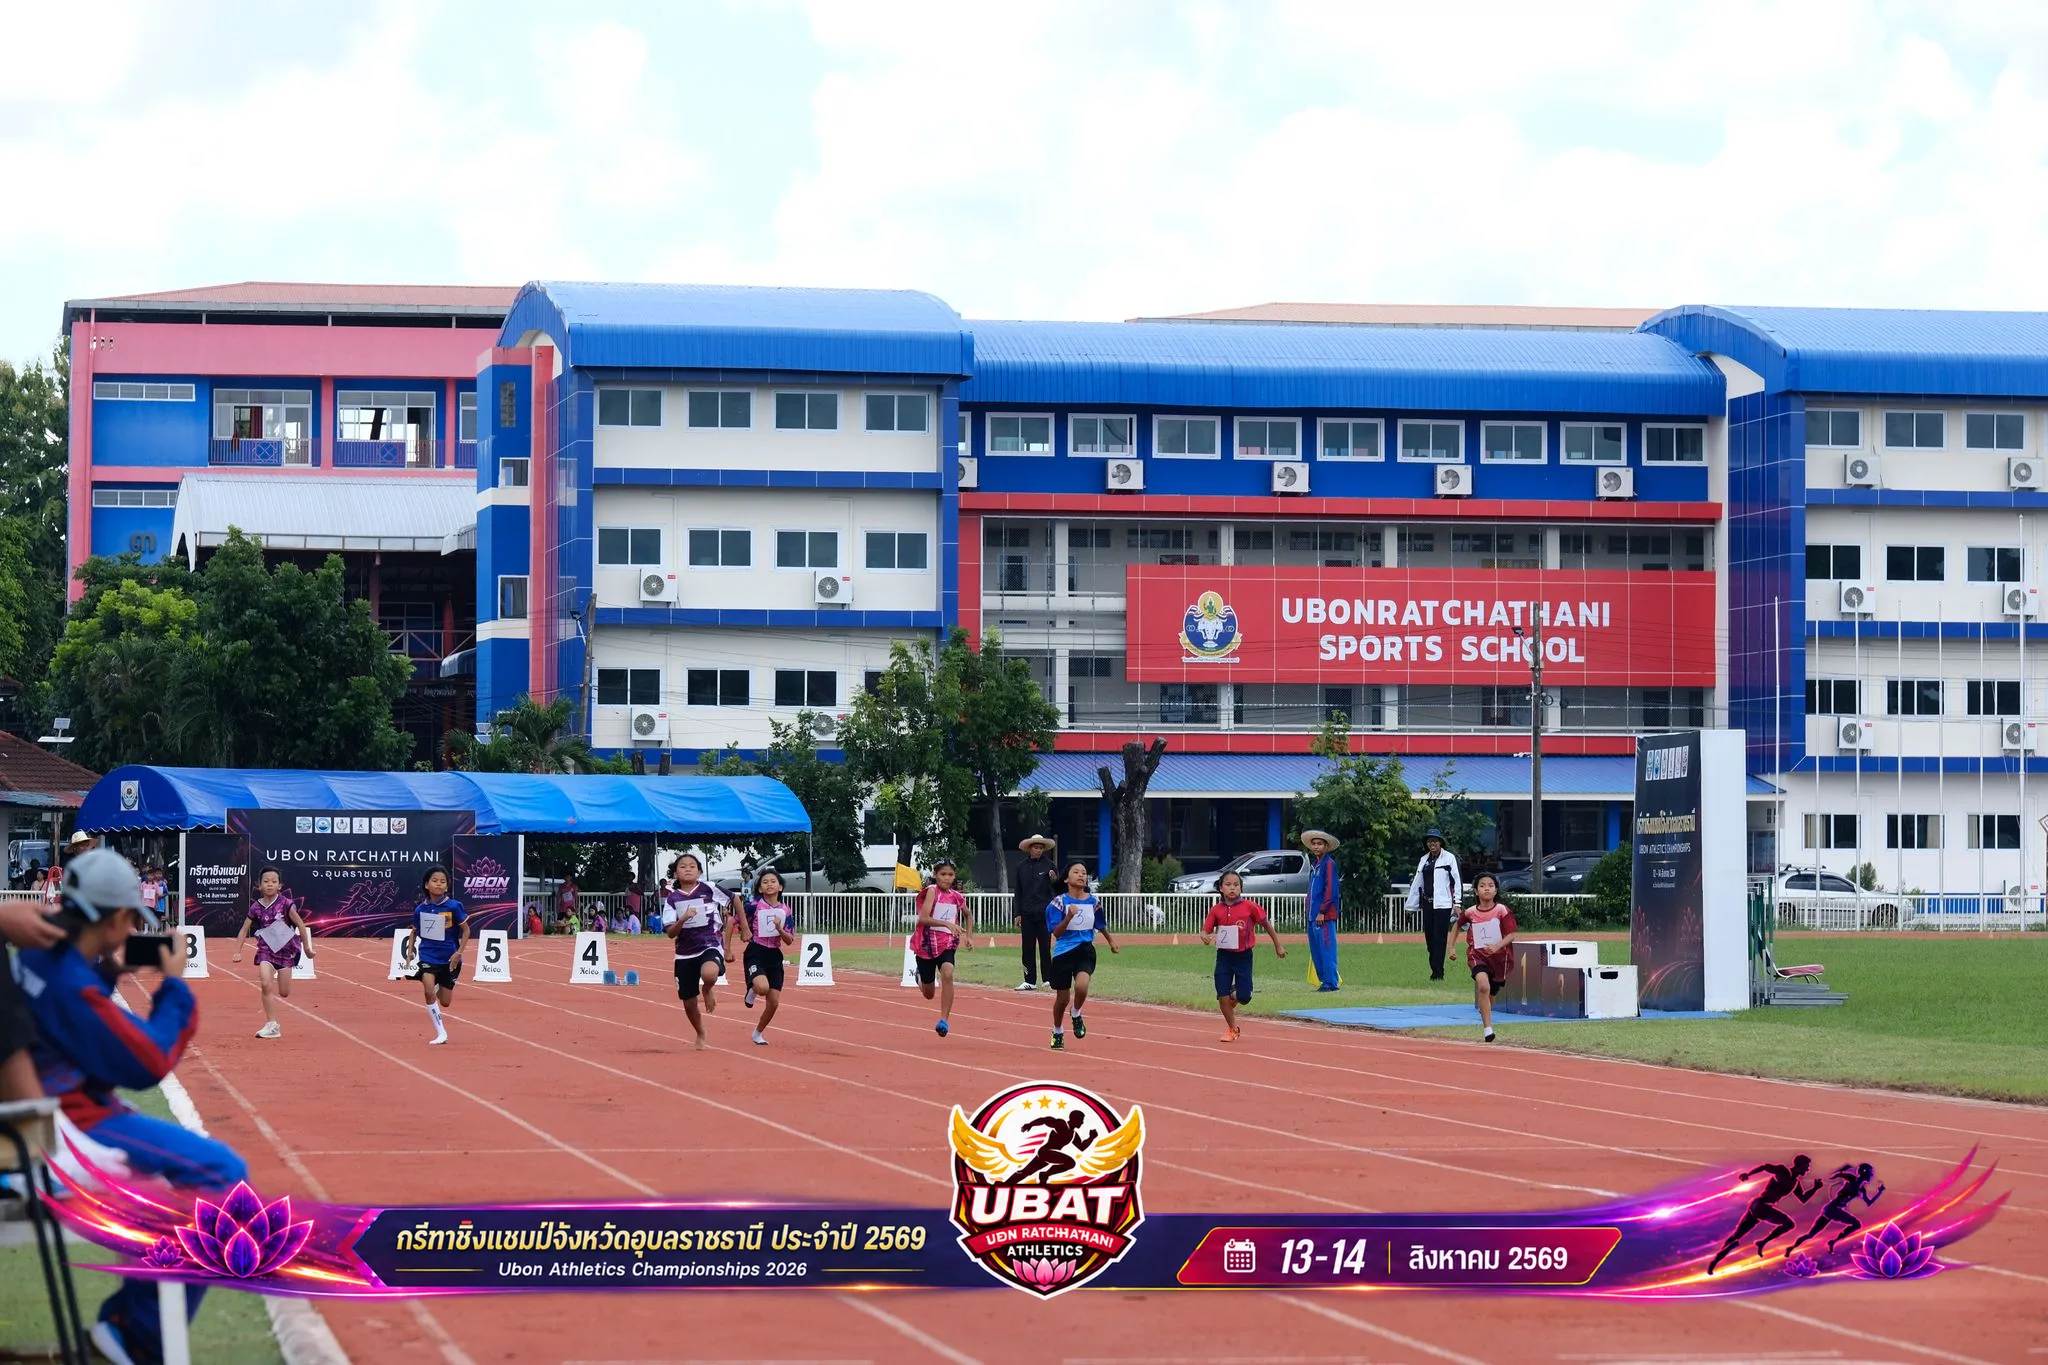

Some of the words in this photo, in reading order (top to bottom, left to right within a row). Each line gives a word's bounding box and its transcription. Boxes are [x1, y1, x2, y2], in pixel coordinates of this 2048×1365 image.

[1282, 597, 1610, 627] UBONRATCHATHANI
[1319, 634, 1442, 662] SPORTS
[1461, 636, 1585, 663] SCHOOL
[266, 849, 318, 862] UBON
[326, 850, 439, 862] RATCHATHANI
[312, 868, 392, 881] จ.อุบลราชธานี
[463, 876, 511, 888] UBON
[424, 919, 436, 934] 7
[1480, 927, 1493, 940] 1
[1220, 929, 1229, 944] 2
[485, 937, 502, 964] 5
[582, 940, 599, 966] 4
[806, 942, 824, 968] 2
